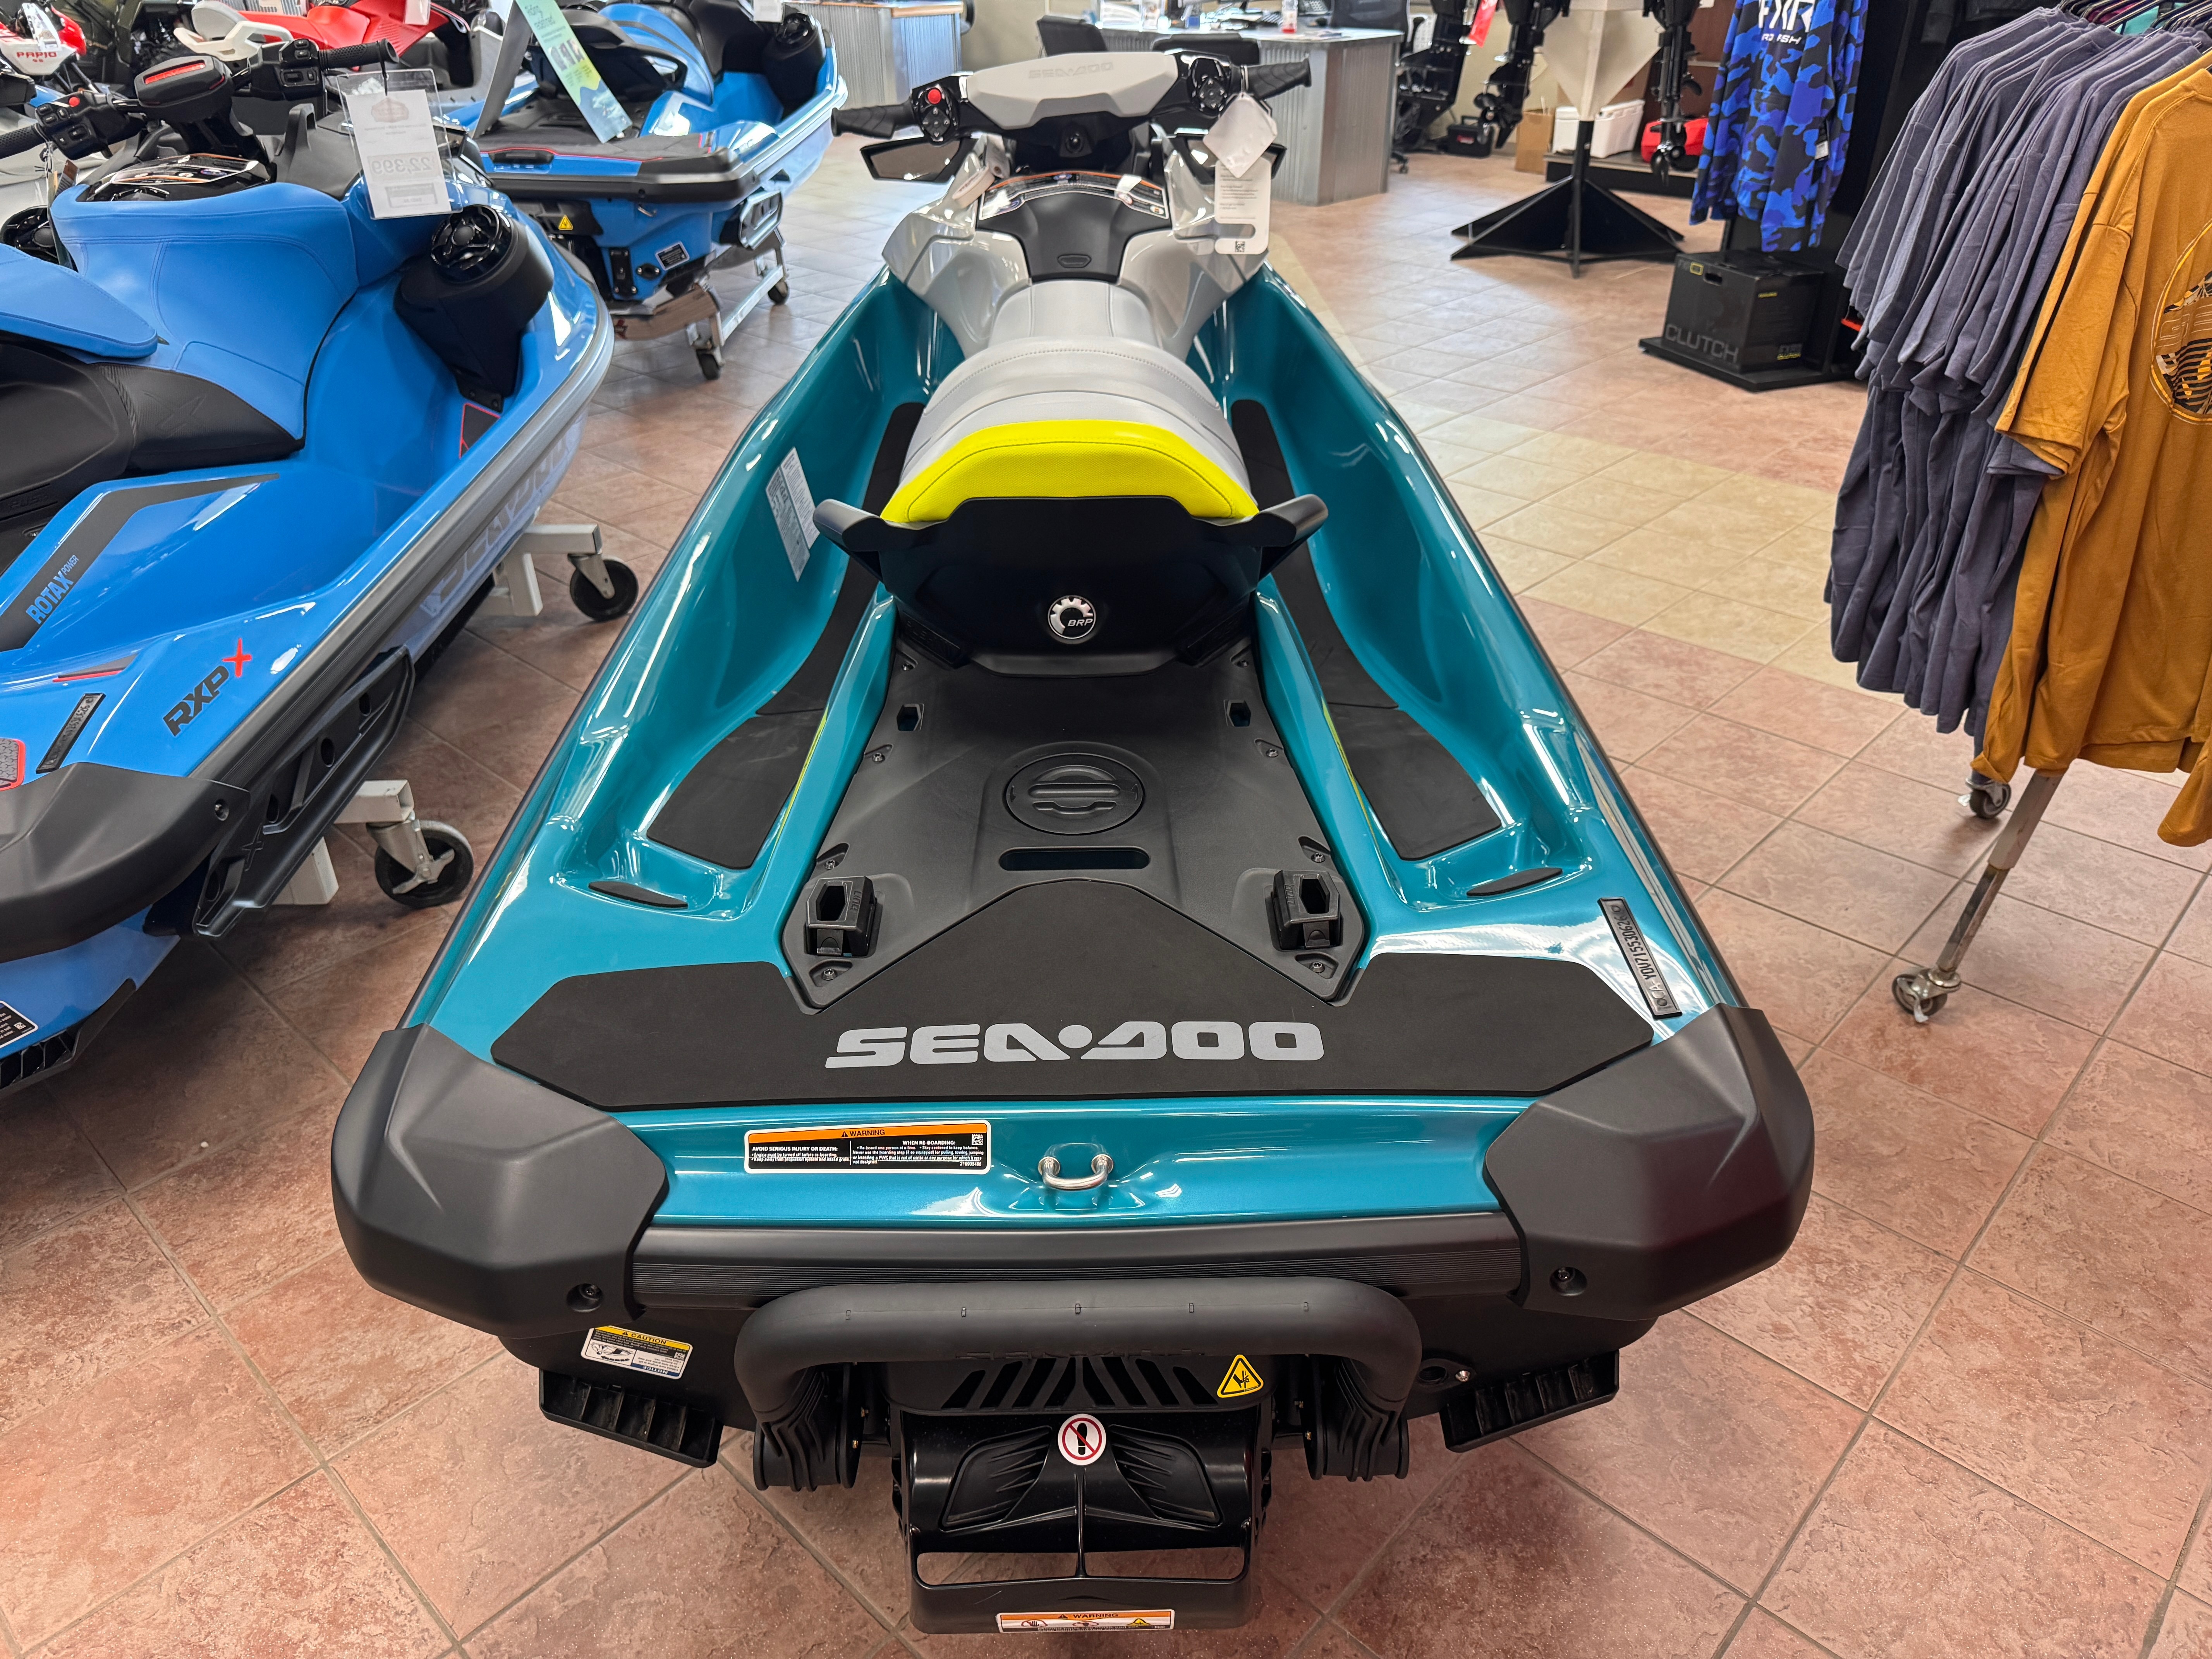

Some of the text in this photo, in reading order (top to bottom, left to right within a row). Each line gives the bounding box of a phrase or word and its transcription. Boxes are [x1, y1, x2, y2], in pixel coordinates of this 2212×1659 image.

[1666, 324, 1739, 364] CLUTCH
[26, 555, 79, 624] ROTAX POWER
[1067, 618, 1093, 627] BRP
[631, 1333, 667, 1345] CAUTION
[643, 1365, 668, 1374] NOTICE
